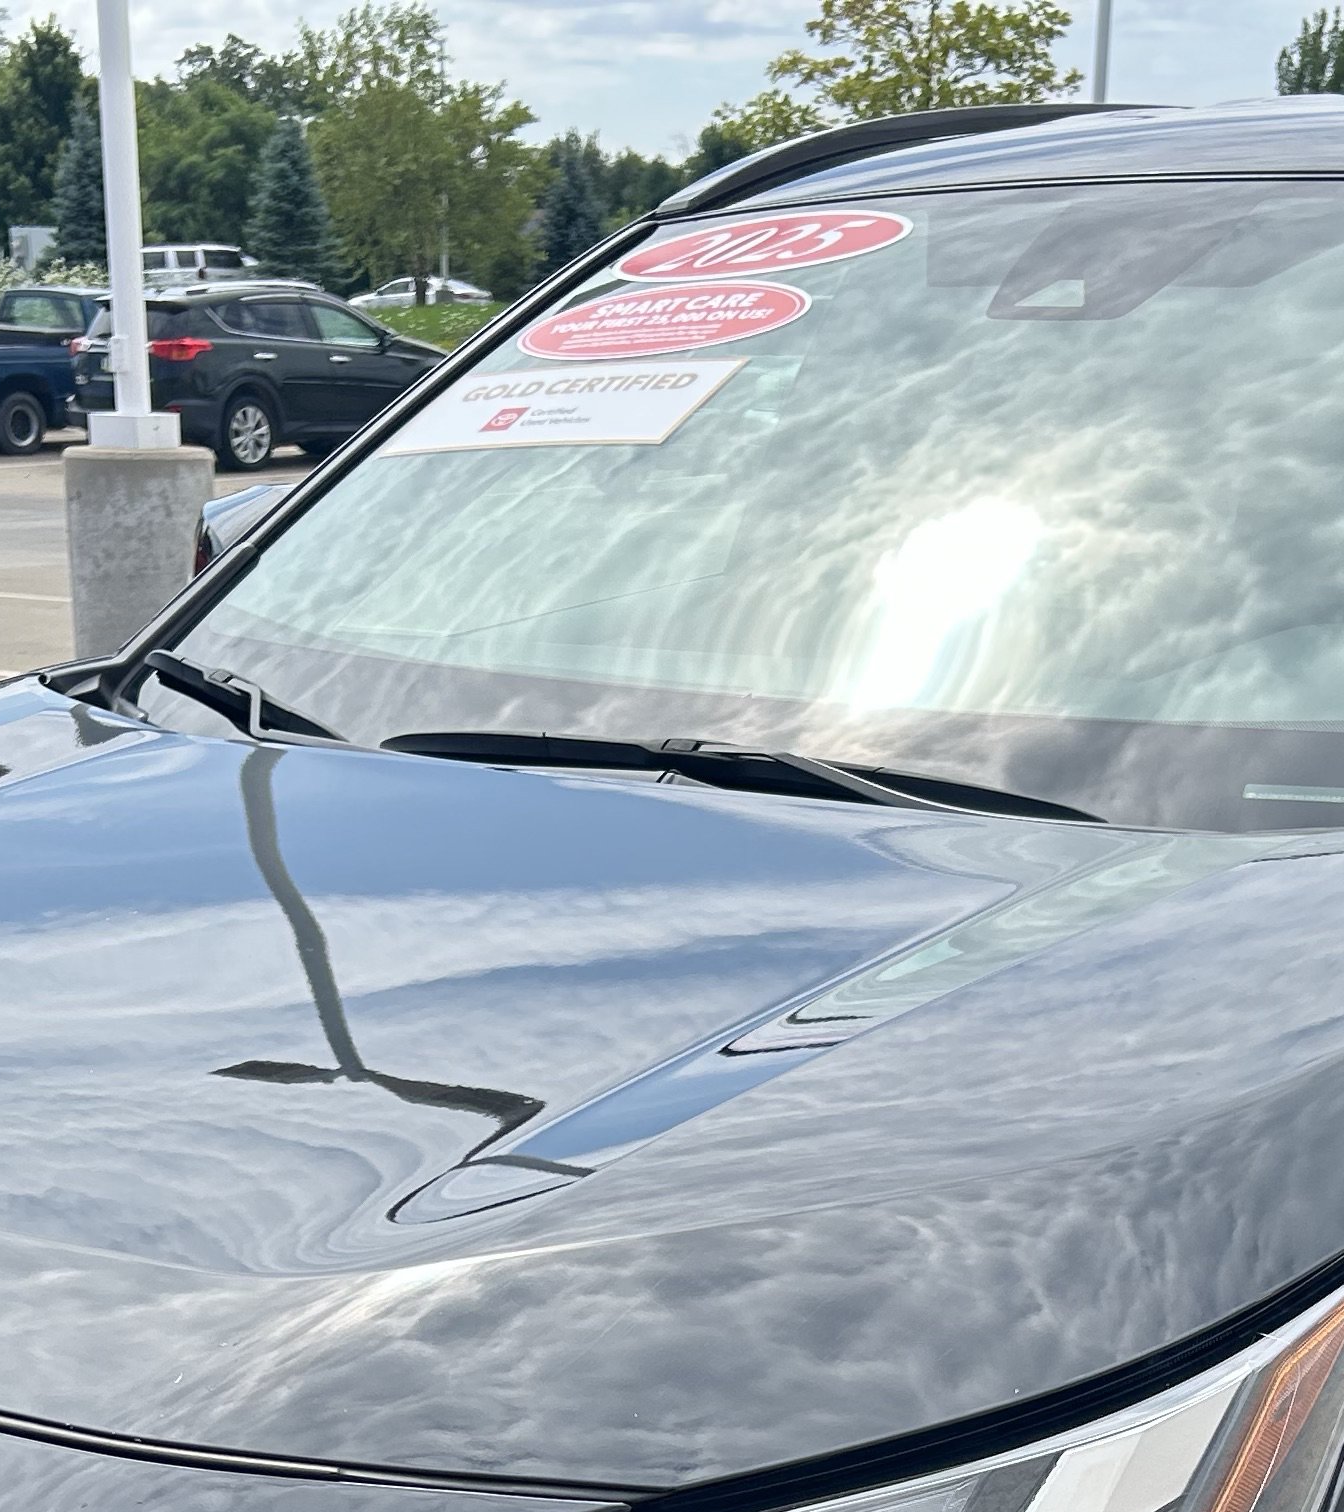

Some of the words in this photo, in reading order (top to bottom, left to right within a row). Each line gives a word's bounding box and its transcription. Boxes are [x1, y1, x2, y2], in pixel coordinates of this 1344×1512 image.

[639, 220, 878, 275] 2025
[589, 297, 688, 319] SMART
[685, 291, 766, 310] CARE
[550, 319, 599, 335] YOUR
[598, 315, 650, 330] FIRST
[705, 309, 738, 323] ON
[737, 308, 776, 321] US!
[462, 381, 545, 402] GOLD
[544, 373, 699, 396] CERTIFIED
